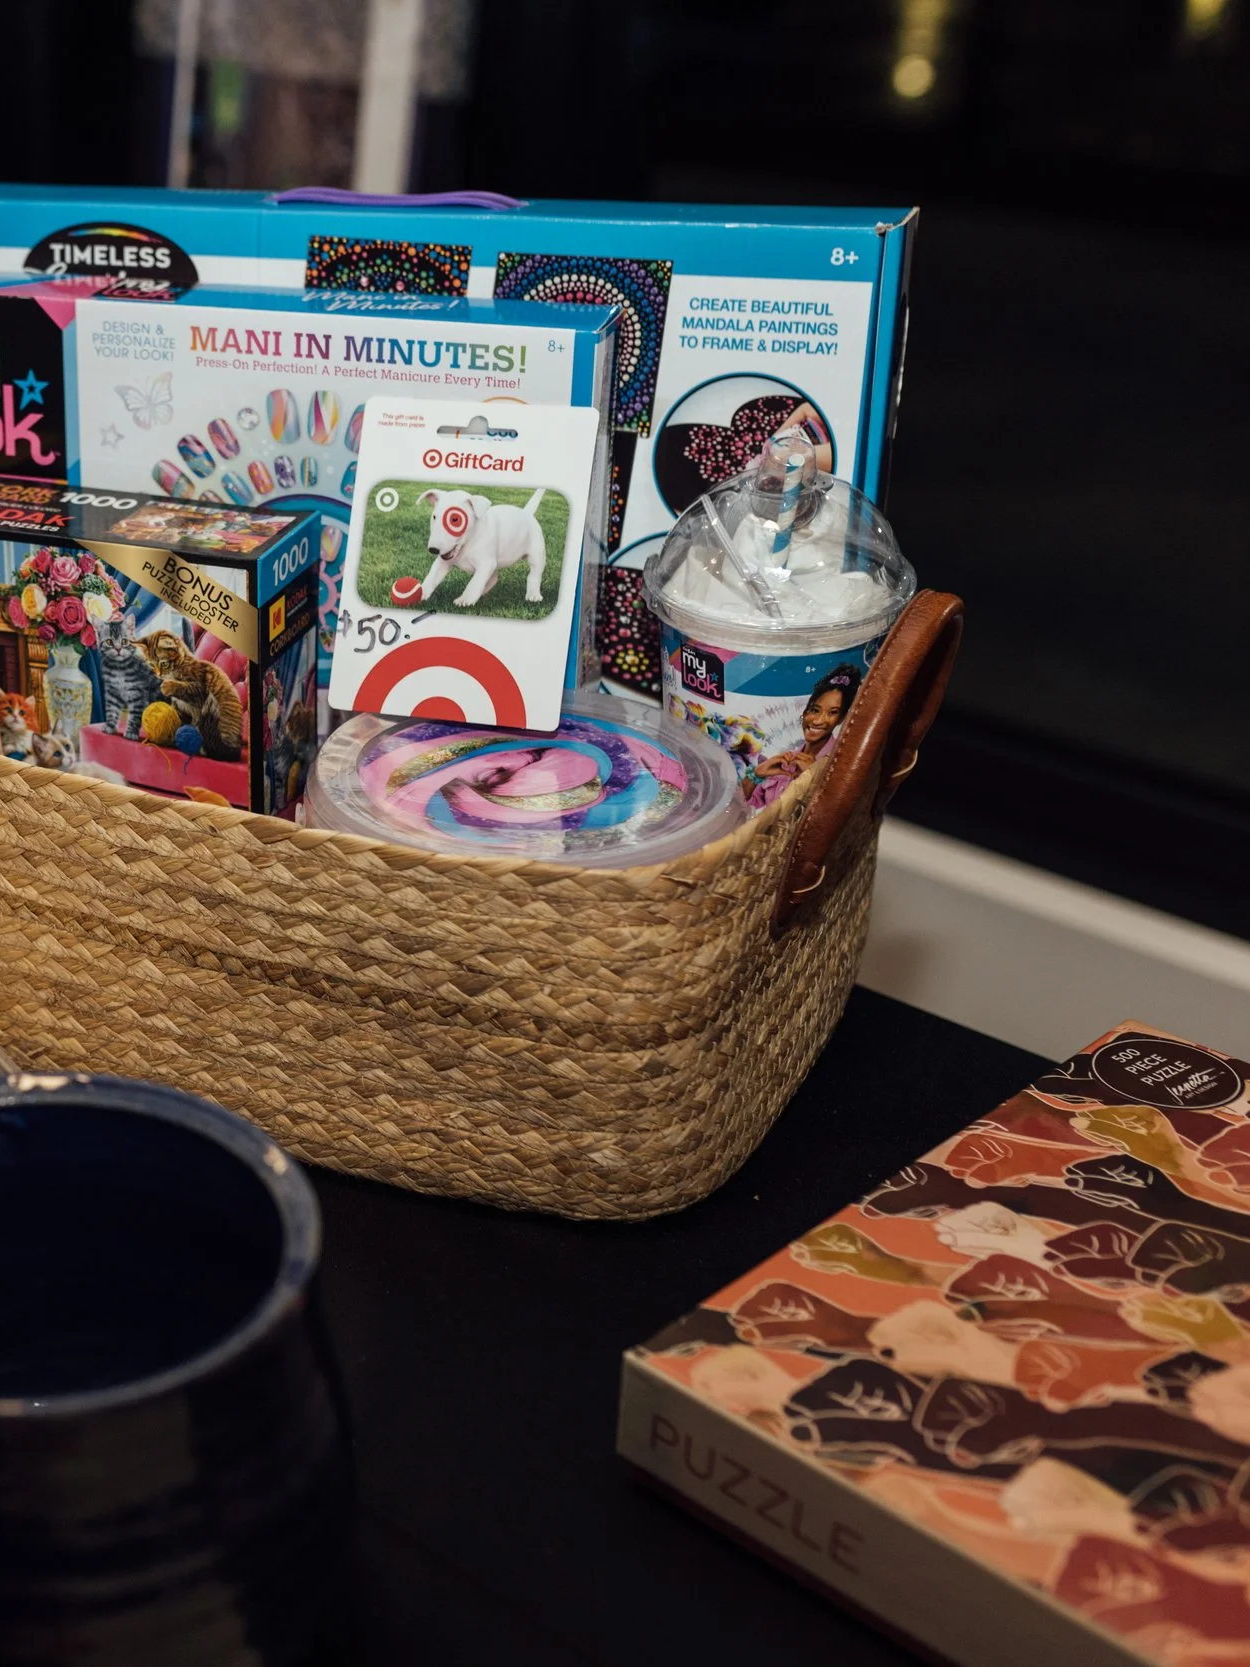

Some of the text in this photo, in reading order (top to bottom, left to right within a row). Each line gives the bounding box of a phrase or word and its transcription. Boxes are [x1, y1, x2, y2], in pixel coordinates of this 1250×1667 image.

[49, 243, 172, 269] TIMELESS
[830, 248, 859, 266] 8+
[689, 297, 833, 316] CREATE BEAUTIFUL
[102, 320, 164, 336] DESIGN &
[681, 316, 838, 336] MANDALA PAINTINGS
[92, 332, 176, 350] PERSONALIZE
[190, 326, 527, 373] MANI IN MINUTES!
[547, 340, 565, 353] 8+
[679, 335, 838, 355] TO FRAME & DISPLAY!
[95, 346, 174, 362] YOUR LOOK!
[195, 356, 521, 389] Press-On Perfection! A Perfect Manicure Every Time!
[445, 452, 525, 472] GiftCard
[60, 492, 138, 510] 1000
[1, 519, 60, 532] PUZZLES
[273, 537, 309, 587] 1000
[163, 557, 234, 611] BONUS
[142, 561, 239, 632] PUZZLE POSTER
[160, 587, 212, 626] INCLUDED
[682, 651, 707, 679] my
[683, 663, 722, 698] look
[1111, 1048, 1141, 1063] 500
[1124, 1053, 1168, 1075] PIECE
[1140, 1060, 1192, 1086] PUZZLE
[652, 1413, 865, 1576] PUZZLE
